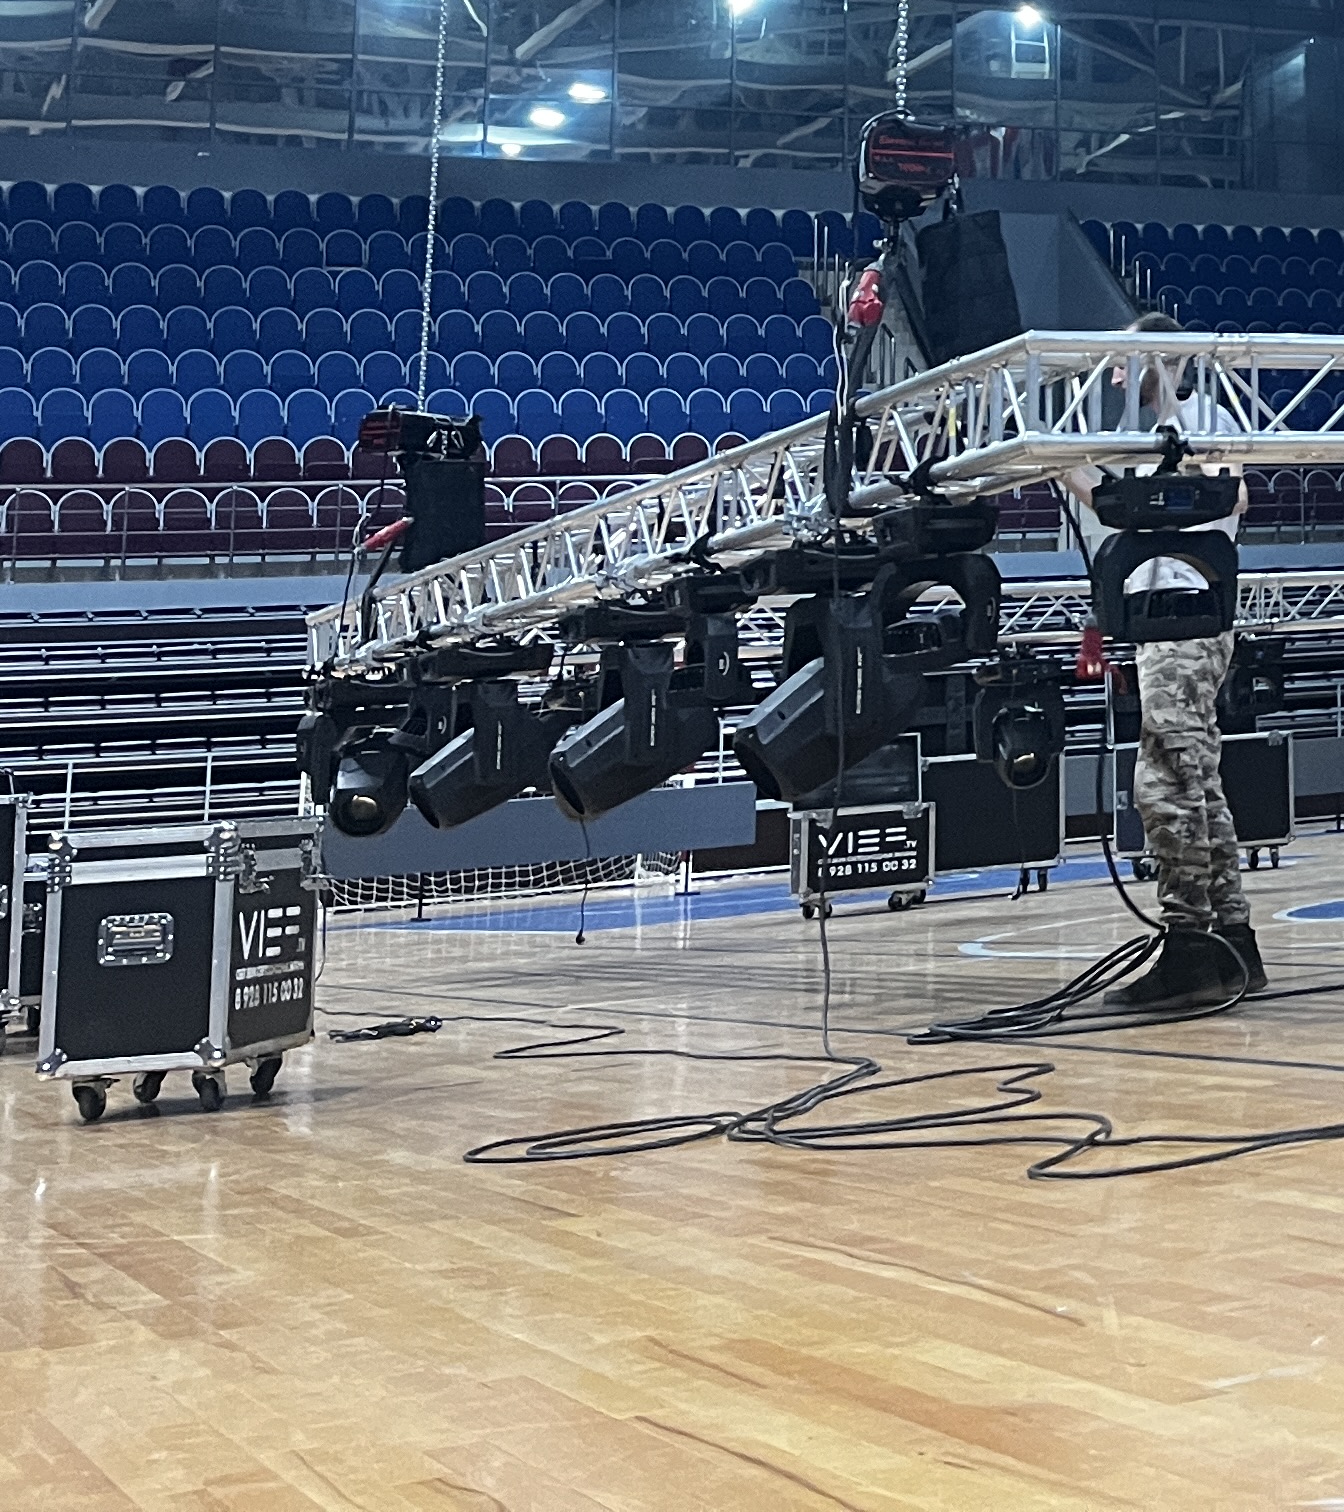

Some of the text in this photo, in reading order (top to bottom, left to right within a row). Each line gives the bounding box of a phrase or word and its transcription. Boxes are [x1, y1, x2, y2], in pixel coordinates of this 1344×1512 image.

[857, 862, 878, 873] 115
[882, 860, 899, 872] 00
[901, 858, 917, 870] 32
[263, 981, 278, 1004] 115
[281, 978, 292, 1001] 00
